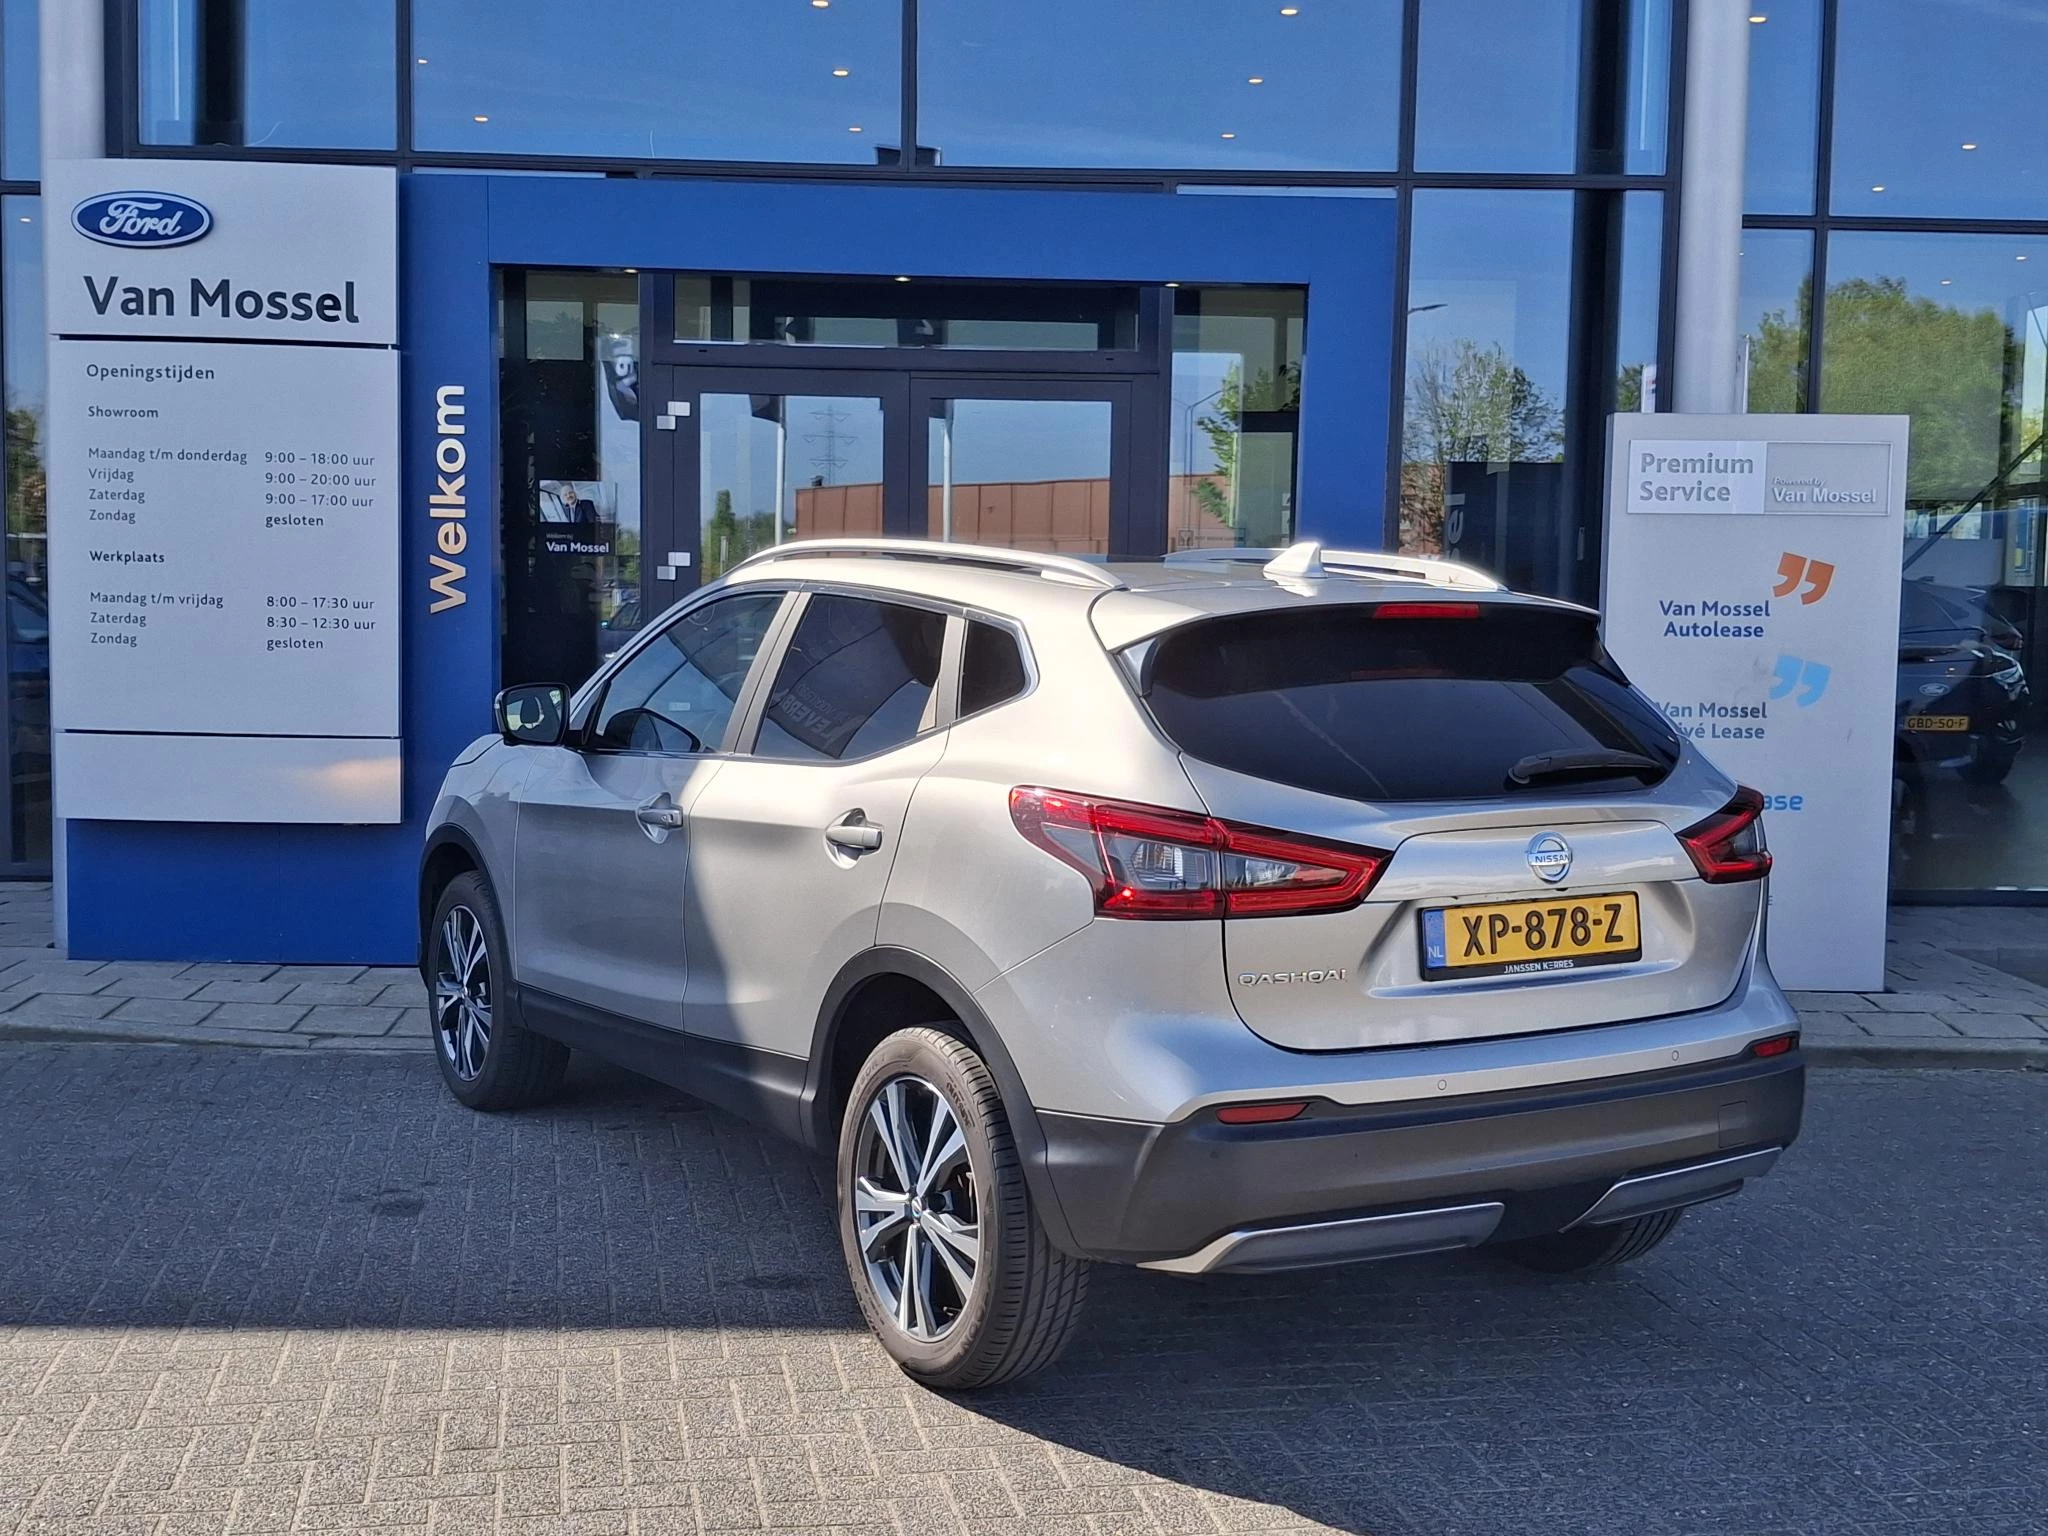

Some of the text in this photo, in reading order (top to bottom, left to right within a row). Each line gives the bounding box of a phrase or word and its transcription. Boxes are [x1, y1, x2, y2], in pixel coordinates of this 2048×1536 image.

[99, 200, 184, 236] Ford
[83, 275, 360, 323] Van Mossel
[86, 364, 215, 383] Openingstijden
[88, 406, 159, 419] Showroom
[88, 448, 248, 465] Maandag t/m donderdag
[265, 452, 295, 464] 9:00
[311, 453, 349, 466] 18:00
[353, 456, 375, 466] uur
[1640, 453, 1753, 474] Premium
[88, 468, 134, 484] Vrijdag
[265, 473, 296, 485] 9:00
[311, 474, 350, 487] 20:00
[354, 477, 376, 487] uur
[89, 489, 145, 505] Zaterdag
[1640, 481, 1731, 501] Service
[1773, 488, 1877, 503] Van Mossel
[266, 494, 296, 505] 9:00
[311, 495, 348, 507] 17:00
[352, 497, 374, 508] uur
[429, 385, 467, 614] Welkom
[89, 509, 136, 525] Zondag
[265, 515, 324, 528] gesloten
[546, 541, 609, 553] Van Mossel
[89, 551, 165, 566] Werkplaats
[90, 592, 224, 609] Maandag t/m vrijdag
[266, 596, 297, 608] 8:00
[312, 597, 349, 609] 17:30
[353, 600, 375, 610] uur
[1659, 600, 1770, 617] Van Mossel
[90, 612, 147, 627] Zaterdag
[266, 617, 297, 628] 8:30
[312, 618, 350, 630] 12:30
[354, 620, 376, 630] uur
[1664, 621, 1764, 638] Autolease
[90, 632, 137, 648] Zondag
[266, 638, 324, 651] gesloten
[1698, 702, 1767, 719] Mossel
[1678, 722, 1765, 739] ivé Lease
[1907, 717, 1966, 729] GBD-50-F
[1764, 795, 1803, 810] ase
[1535, 854, 1569, 863] NISSAN
[1462, 903, 1624, 957] XP-878-Z
[1428, 947, 1444, 958] NL
[1504, 960, 1574, 974] JANSSEN KERRES
[1239, 968, 1347, 987] QASHQAI
